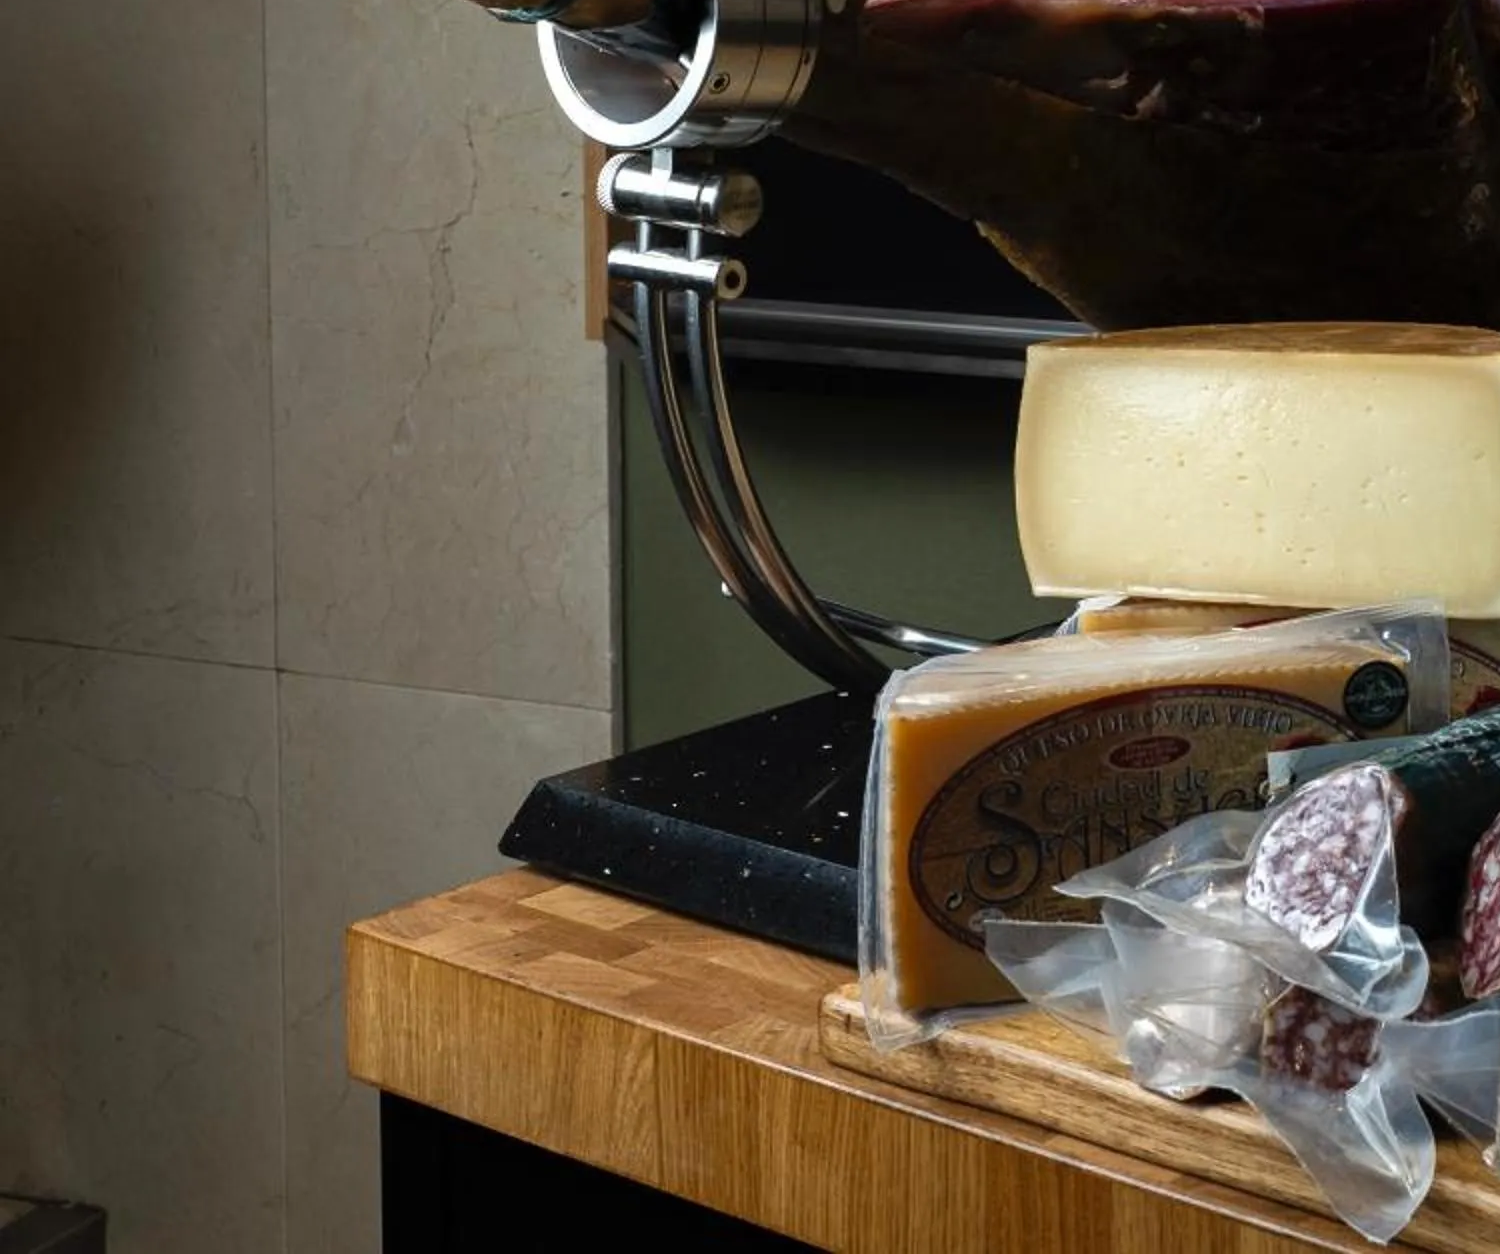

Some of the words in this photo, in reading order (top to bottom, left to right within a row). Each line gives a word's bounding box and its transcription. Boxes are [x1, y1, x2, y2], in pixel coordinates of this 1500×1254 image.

[997, 727, 1089, 776] QUESO
[1042, 769, 1161, 816] Ciudad
[1173, 766, 1208, 793] de
